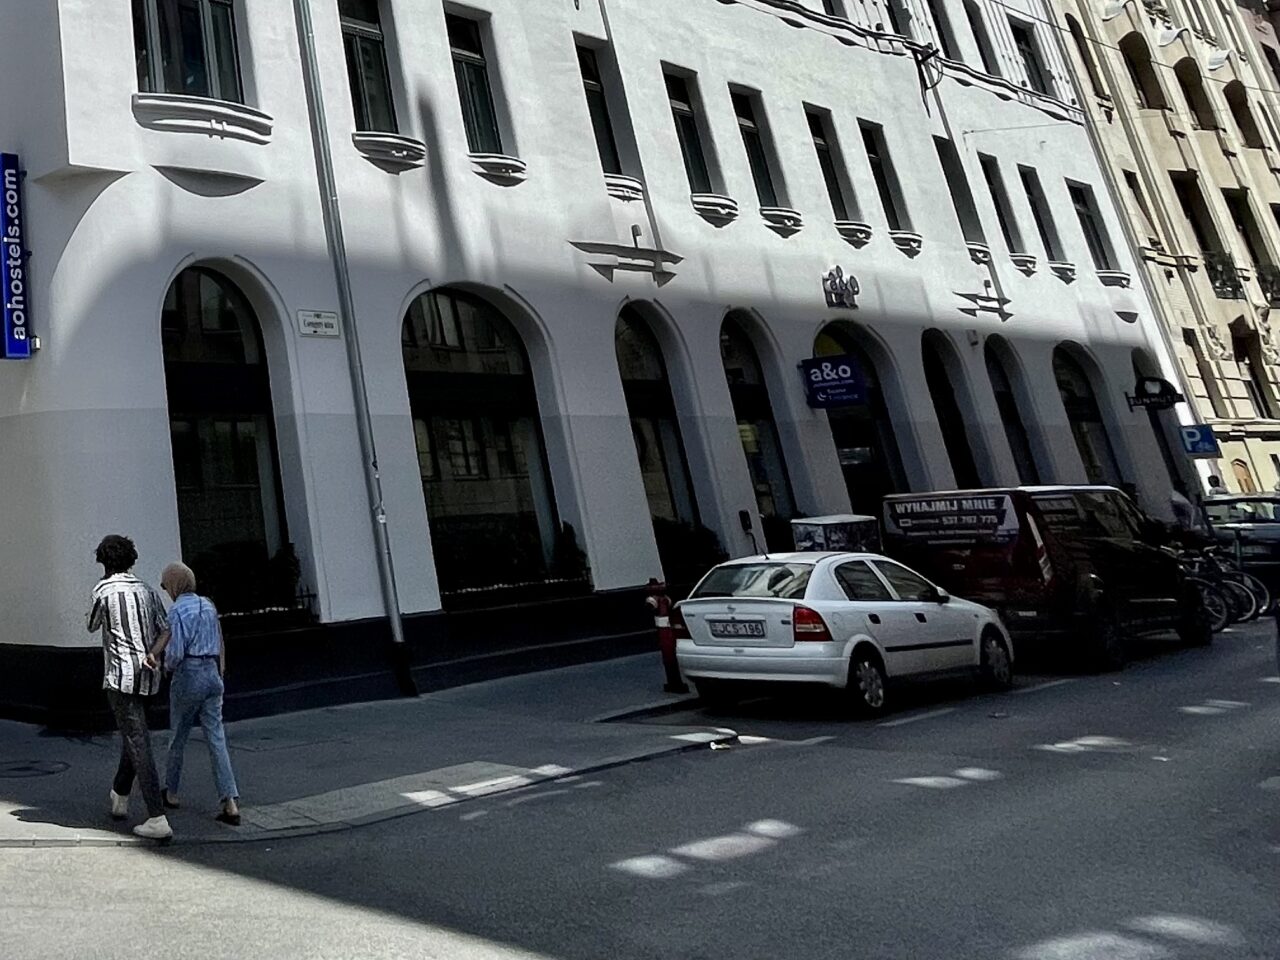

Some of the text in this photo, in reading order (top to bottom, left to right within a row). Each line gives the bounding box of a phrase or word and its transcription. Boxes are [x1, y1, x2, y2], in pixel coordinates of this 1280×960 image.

[2, 168, 25, 340] aohostels.com
[809, 362, 852, 382] a&o
[720, 623, 762, 634] JCS-196
